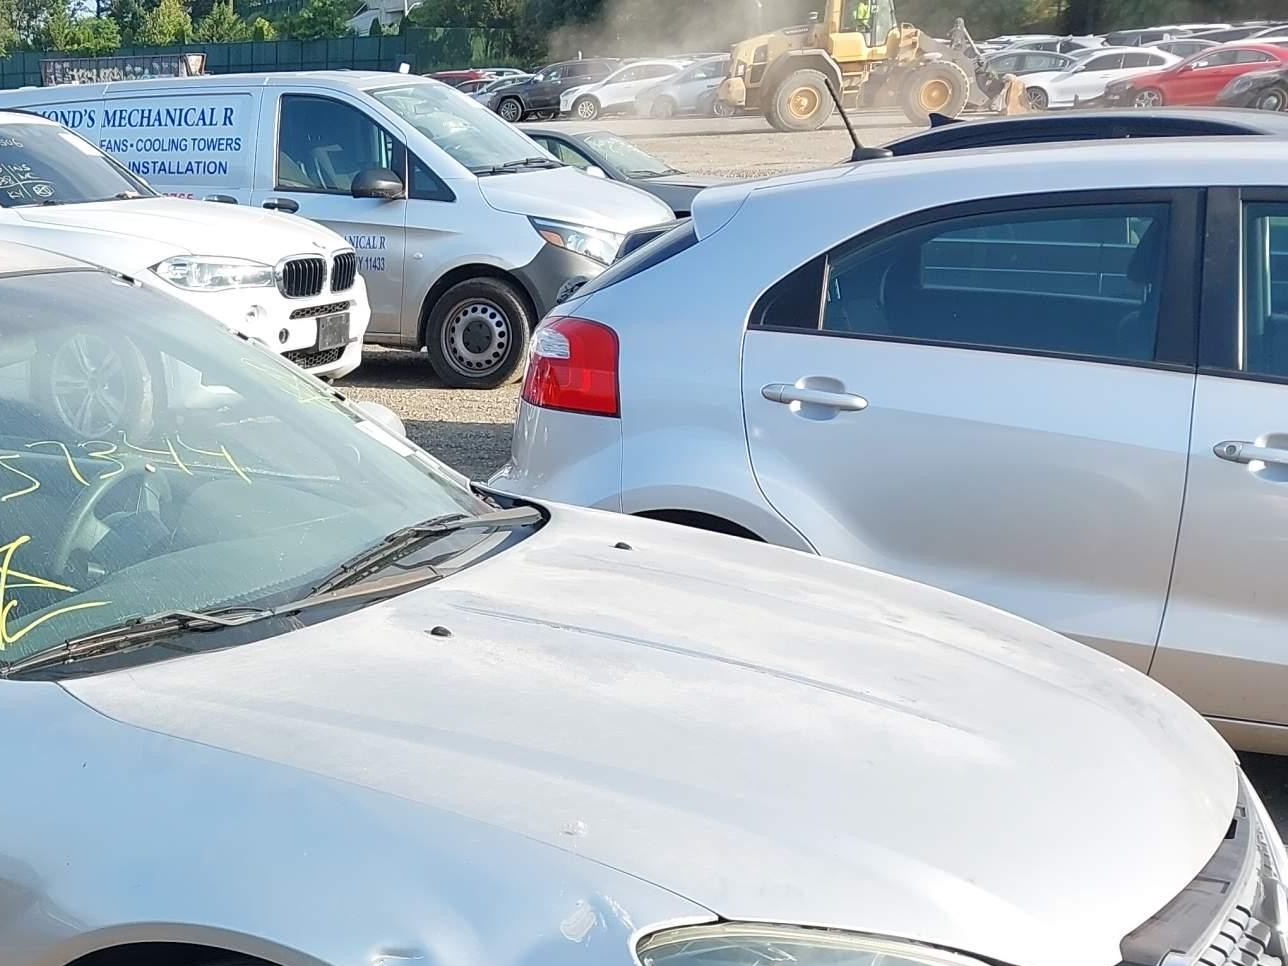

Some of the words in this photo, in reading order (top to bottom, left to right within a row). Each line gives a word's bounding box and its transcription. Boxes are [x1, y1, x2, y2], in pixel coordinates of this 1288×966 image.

[42, 109, 95, 128] OND'S
[101, 108, 218, 127] MECHANICAL
[222, 107, 234, 126] R
[136, 138, 187, 151] COOLING
[191, 138, 241, 151] TOWERS
[128, 161, 228, 175] INSTALLATION
[344, 235, 377, 249] NICAL
[365, 257, 385, 271] 11433
